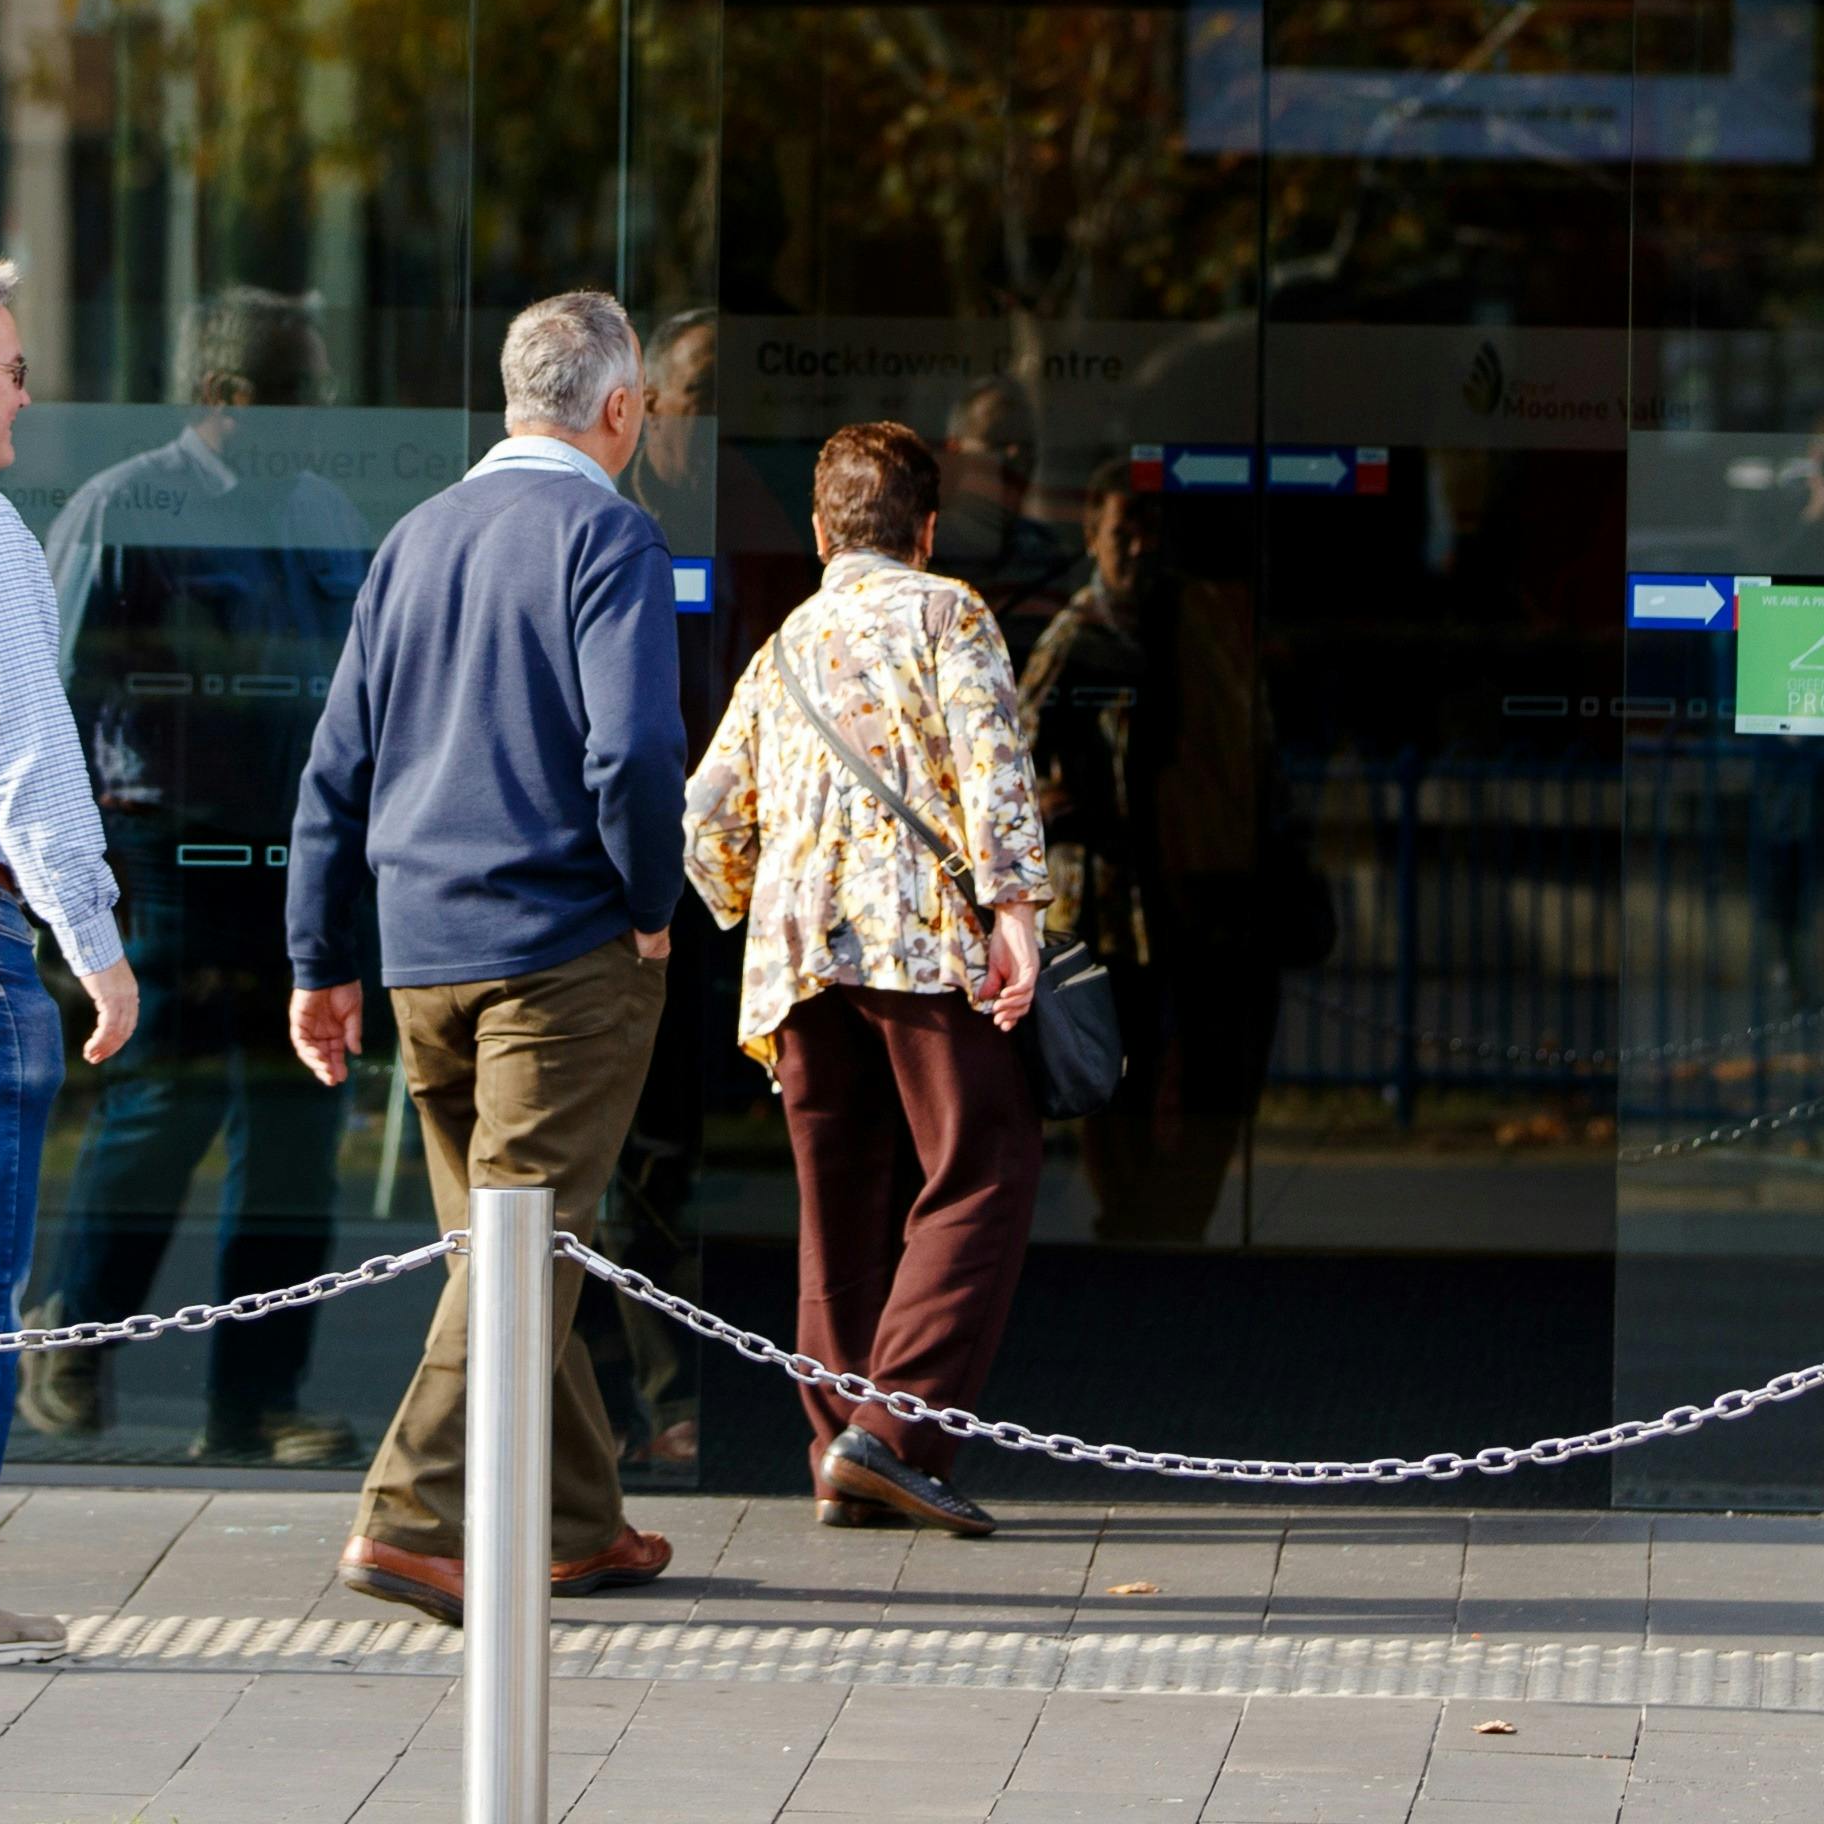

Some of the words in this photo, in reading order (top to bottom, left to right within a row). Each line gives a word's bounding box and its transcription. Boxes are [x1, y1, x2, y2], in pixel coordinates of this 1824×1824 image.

[1762, 595, 1778, 606] WE
[1780, 595, 1799, 606] ARE
[1802, 596, 1811, 606] A
